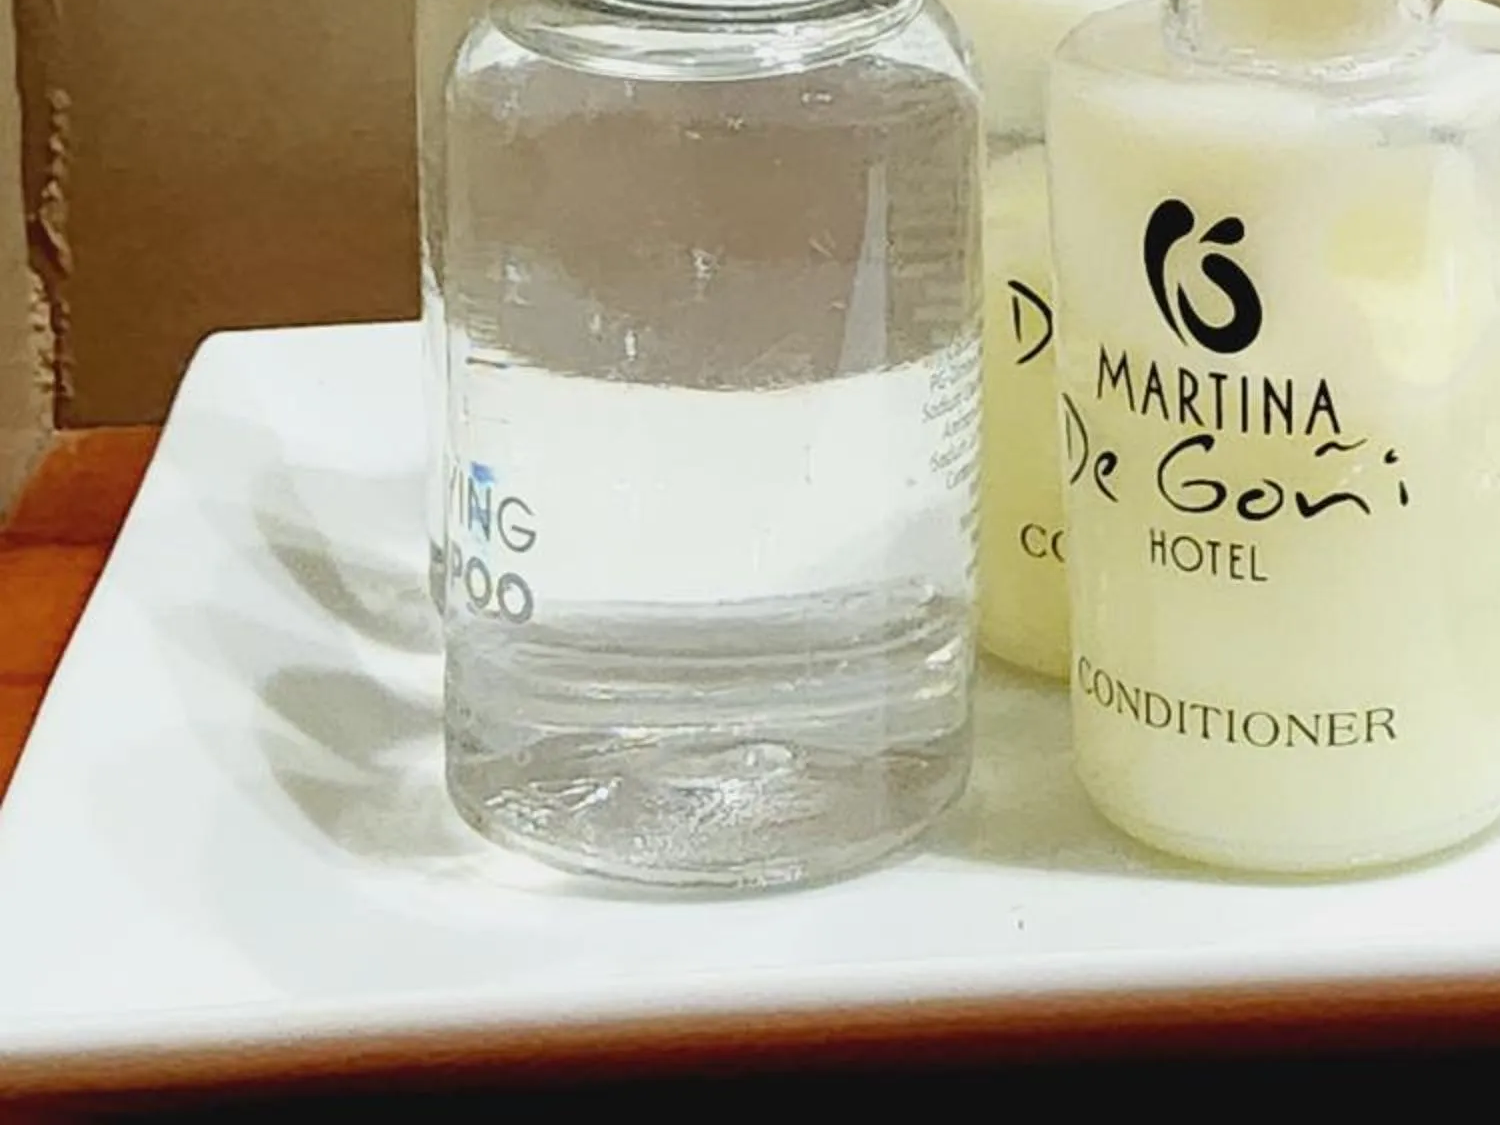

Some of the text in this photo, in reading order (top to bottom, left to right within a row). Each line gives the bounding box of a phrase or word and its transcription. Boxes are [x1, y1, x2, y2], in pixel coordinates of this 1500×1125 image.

[1096, 344, 1342, 436] MARTINA
[1061, 391, 1409, 522] De Goñi
[1148, 528, 1269, 583] HOTEL
[1076, 655, 1398, 749] CONDITIONER
